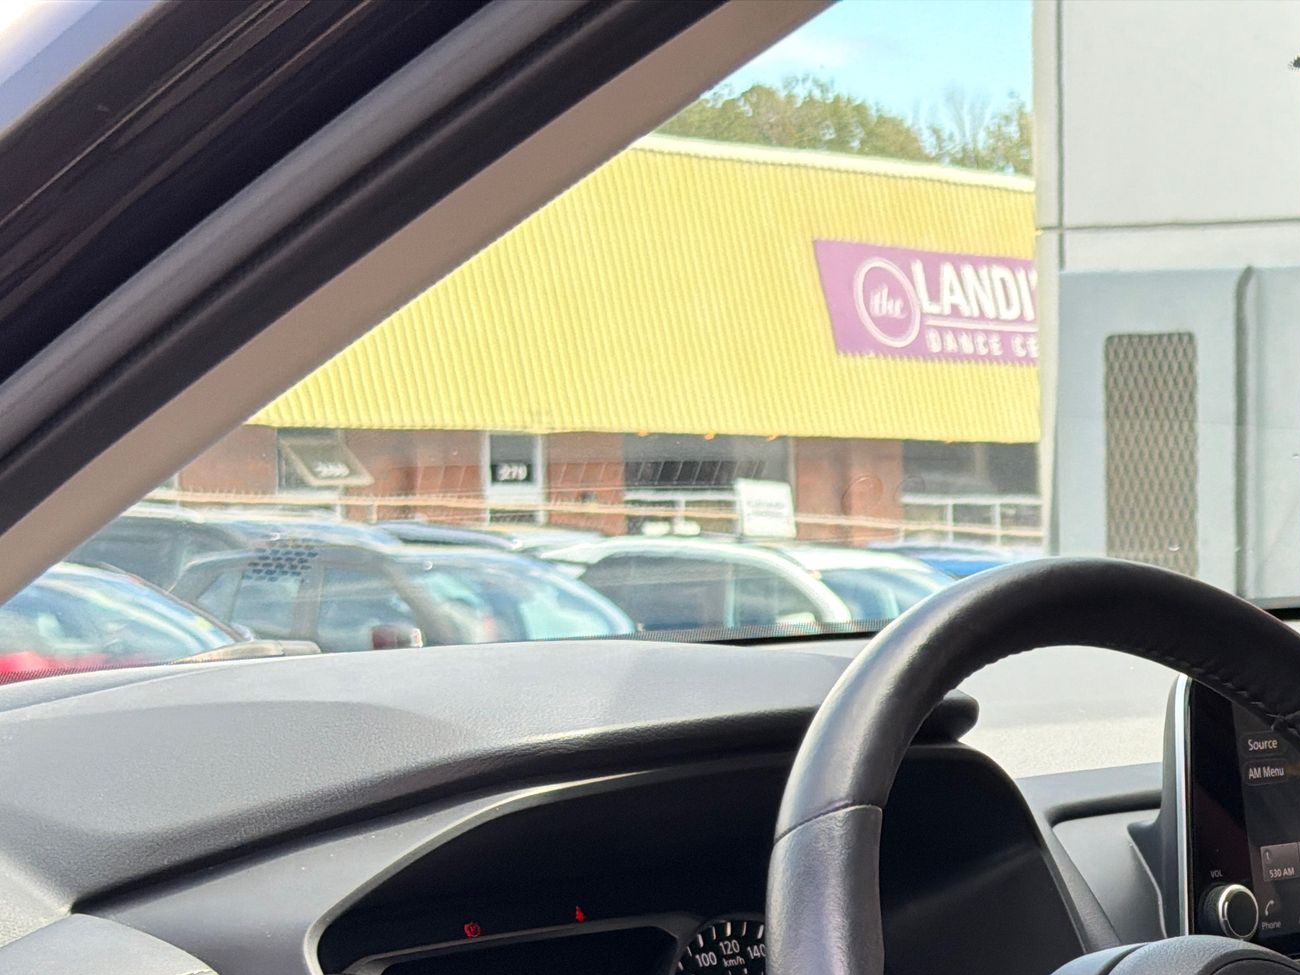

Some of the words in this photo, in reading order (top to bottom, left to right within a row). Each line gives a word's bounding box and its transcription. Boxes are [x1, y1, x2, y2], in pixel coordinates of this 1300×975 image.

[925, 328, 1003, 356] DANCE
[1247, 738, 1278, 751] Source
[1248, 767, 1262, 780] AM
[1263, 766, 1285, 779] Menu
[1210, 870, 1223, 878] VOL
[1268, 868, 1281, 878] 530
[1282, 867, 1295, 877] AM
[1261, 921, 1281, 930] Phone
[719, 939, 740, 955] 120
[747, 943, 766, 960] 140
[695, 951, 718, 967] 100
[723, 956, 745, 967] km/h
